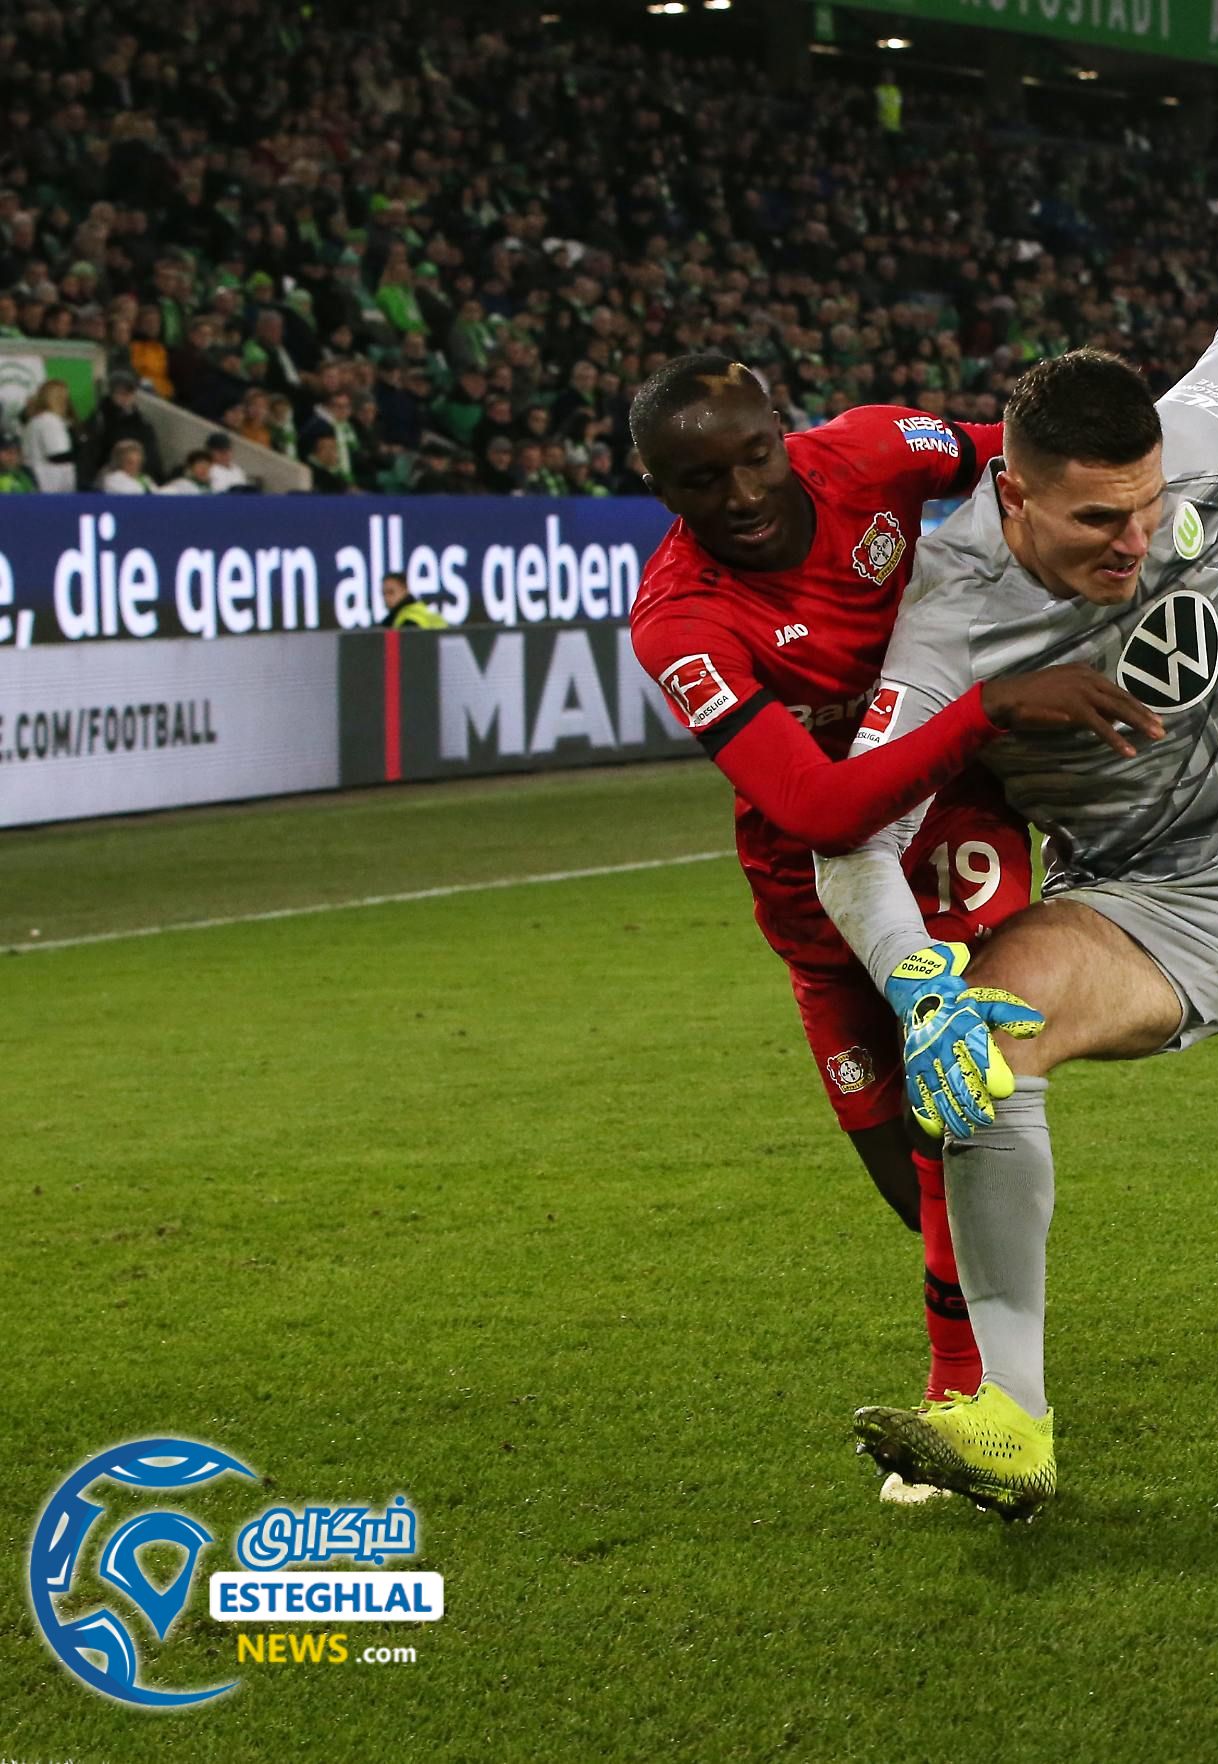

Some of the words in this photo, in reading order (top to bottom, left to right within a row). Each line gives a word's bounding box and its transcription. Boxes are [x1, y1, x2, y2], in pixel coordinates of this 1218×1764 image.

[54, 511, 159, 640] die
[175, 546, 319, 640] gern
[334, 514, 471, 630] alles
[481, 513, 642, 628] geben
[694, 695, 729, 725] DESLIGA
[929, 840, 1001, 913] 19
